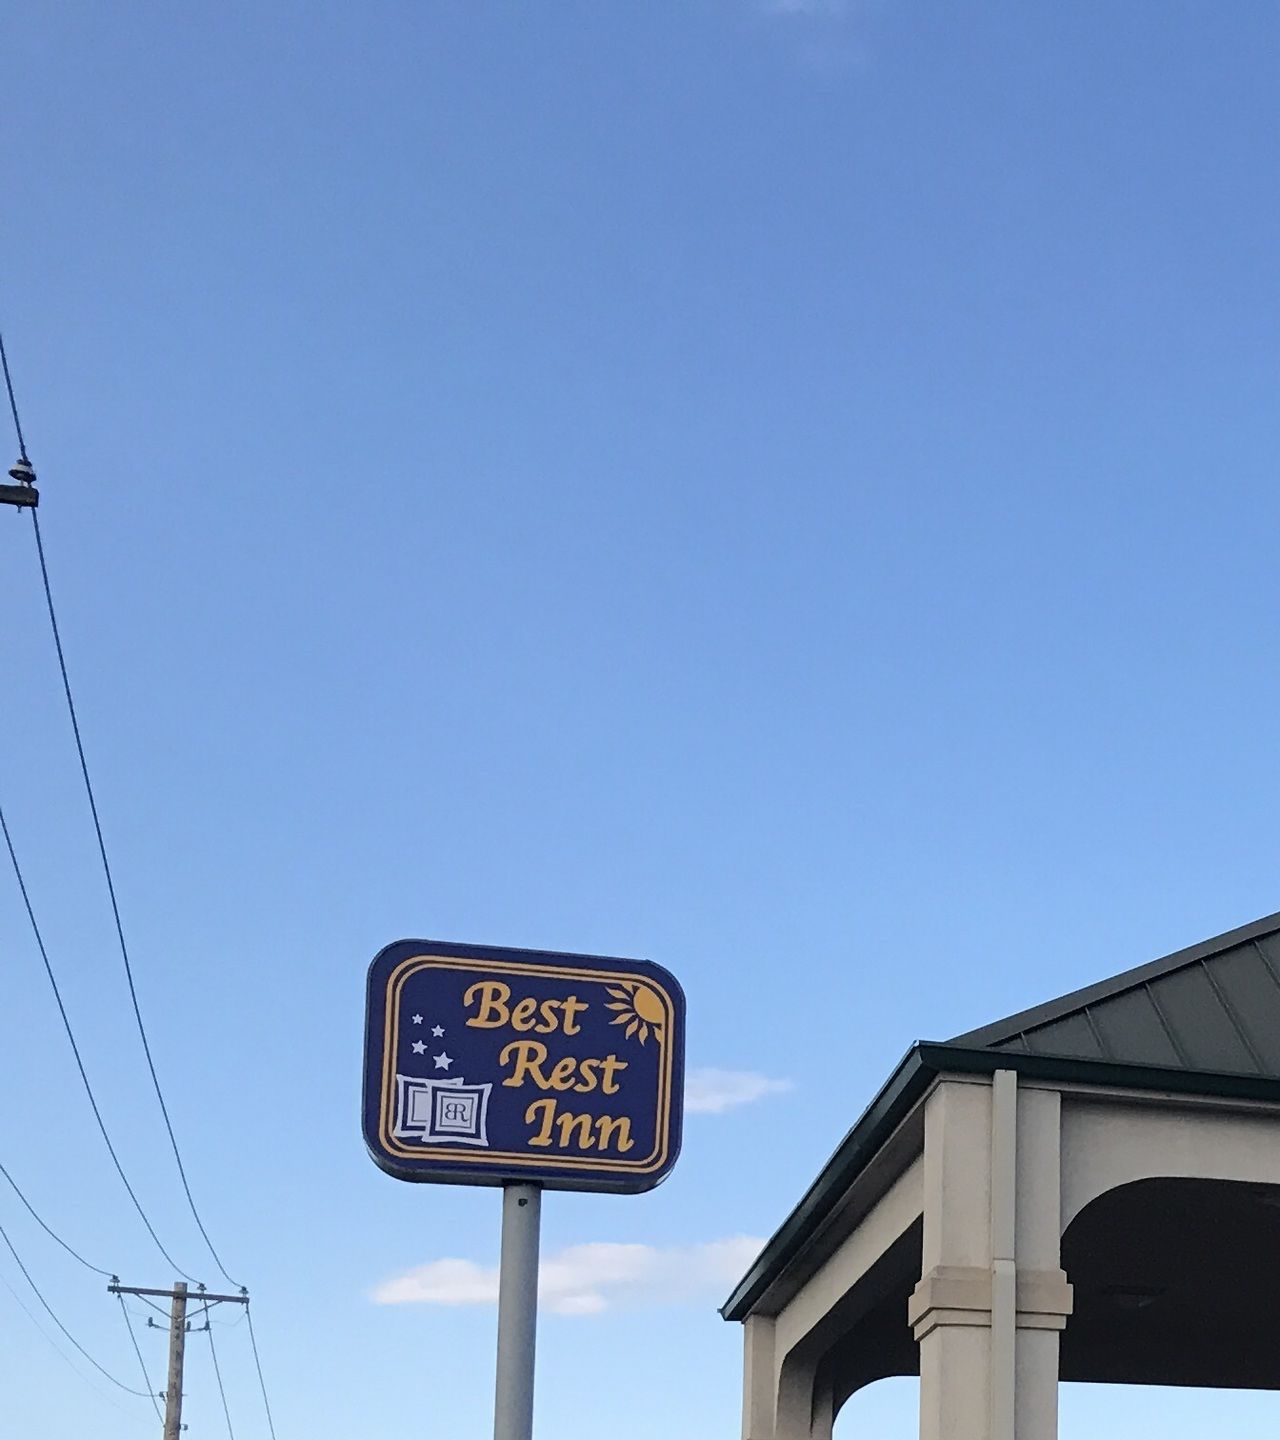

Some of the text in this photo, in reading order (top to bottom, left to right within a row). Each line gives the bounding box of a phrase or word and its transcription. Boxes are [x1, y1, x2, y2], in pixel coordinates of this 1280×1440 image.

[463, 980, 589, 1035] Best
[499, 1040, 628, 1095] Rest
[525, 1098, 634, 1152] Inn
